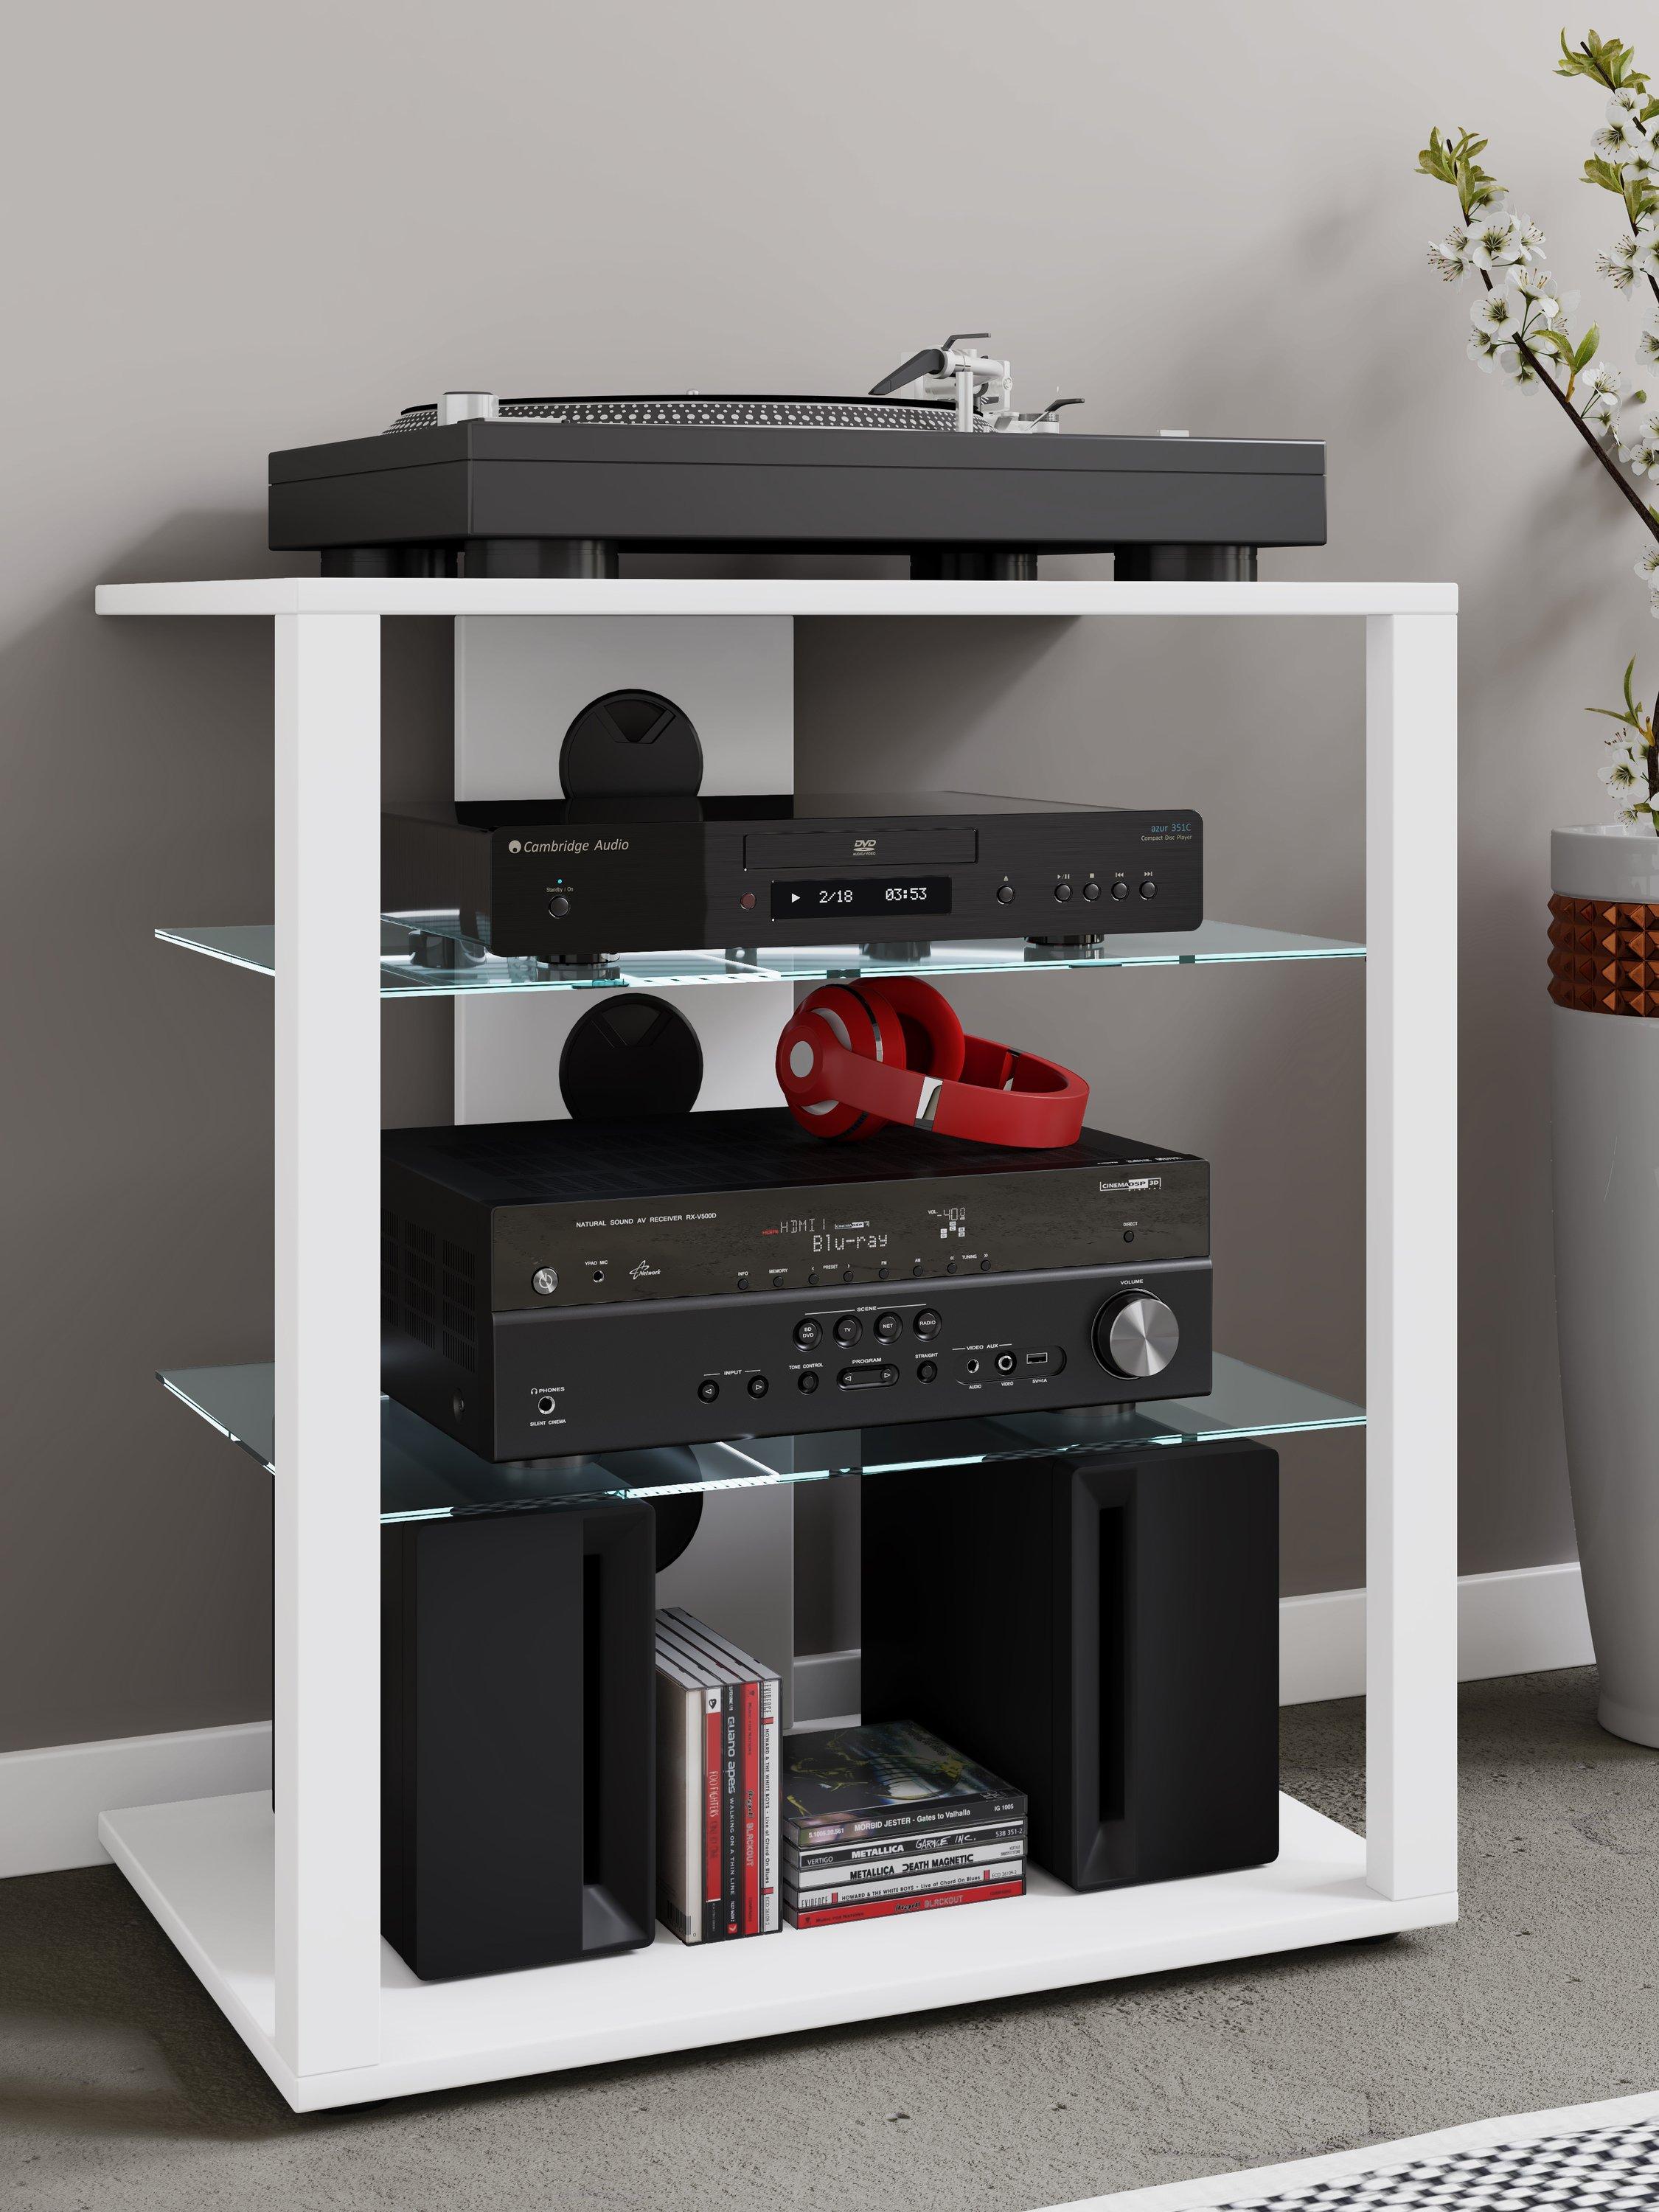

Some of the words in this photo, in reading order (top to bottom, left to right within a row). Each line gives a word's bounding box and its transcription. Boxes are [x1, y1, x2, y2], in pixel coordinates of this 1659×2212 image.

[1151, 824, 1168, 833] azur
[1171, 823, 1192, 832] 351C
[524, 840, 589, 854] Cambridge
[594, 838, 629, 851] Audio
[855, 839, 876, 847] DVD
[819, 890, 853, 903] 2/18
[886, 887, 927, 901] 03:53
[650, 1214, 683, 1222] RECEIVER
[780, 1218, 815, 1234] HDMI
[813, 1234, 887, 1252] Blu-ray
[639, 1268, 661, 1276] Network
[709, 1771, 717, 1785] FOO
[727, 1761, 736, 1794] apes
[709, 1787, 719, 1818] FIGHTERS
[854, 1821, 883, 1832] MORBID
[884, 1817, 911, 1828] JESTER
[917, 1814, 936, 1824] Gates
[945, 1809, 970, 1819] Valhalla
[995, 1829, 1006, 1837] 538
[1007, 1828, 1023, 1836] 351-2
[730, 1836, 734, 1846] ON
[851, 1844, 904, 1859] METALLICA
[954, 1832, 976, 1844] INC.
[765, 1858, 770, 1866] On
[807, 1856, 833, 1865] VERTIGO
[850, 1865, 894, 1879] METALLICA
[902, 1861, 929, 1872] DEATH
[931, 1854, 974, 1868] MAGNETIC
[842, 1893, 865, 1901] HOWARD
[924, 1894, 964, 1908] BLACKOUT
